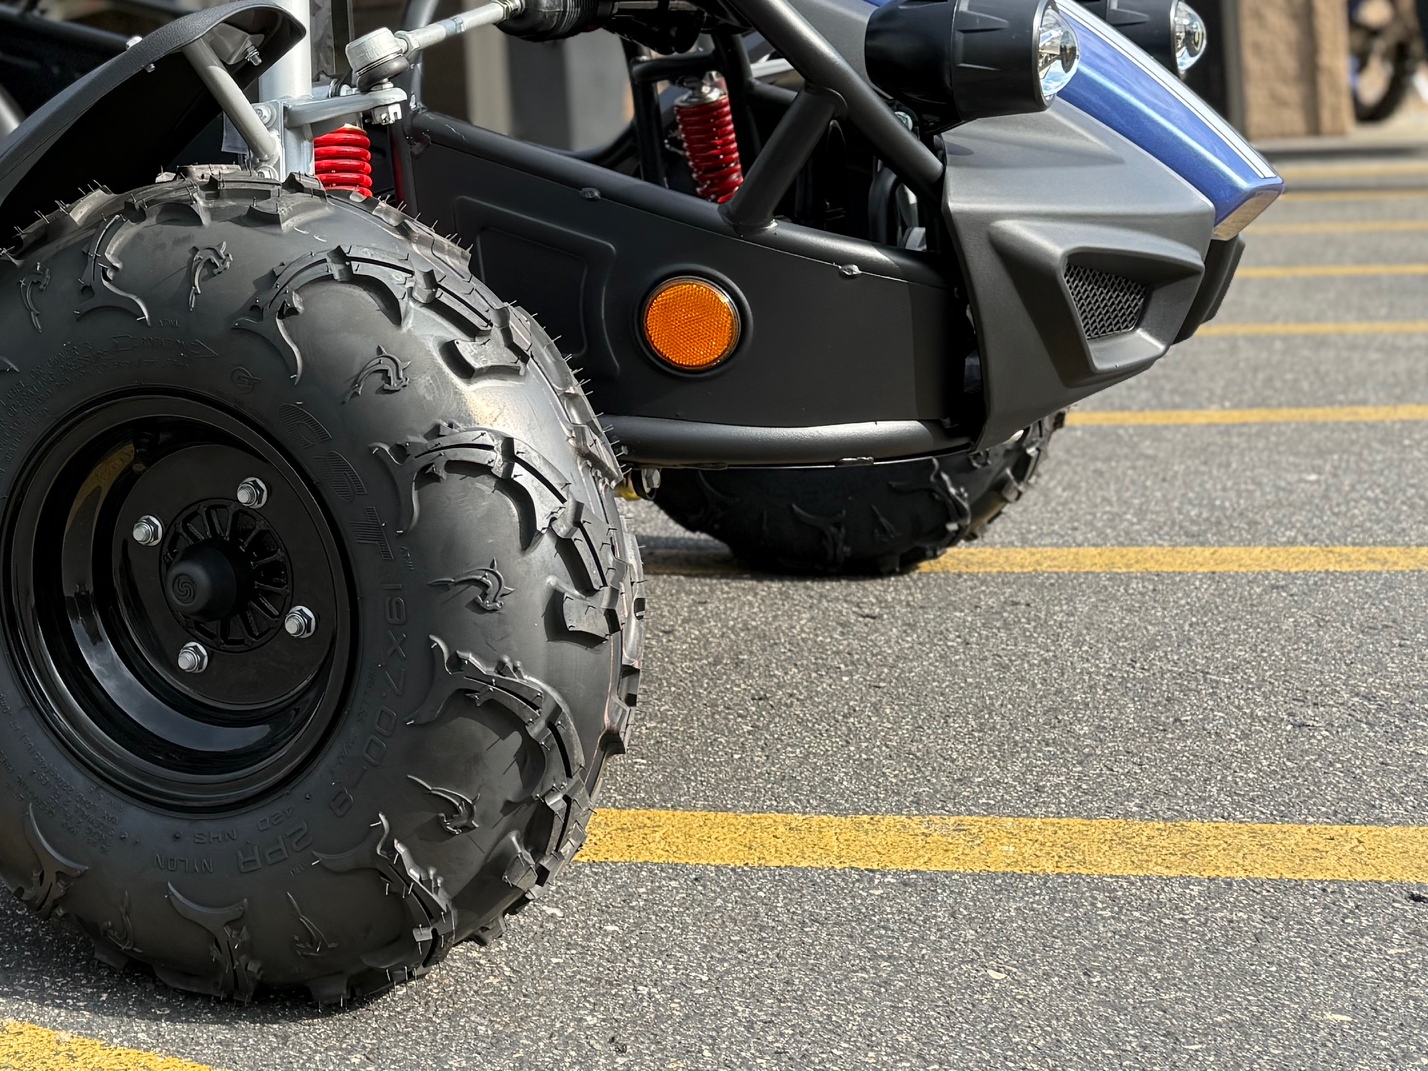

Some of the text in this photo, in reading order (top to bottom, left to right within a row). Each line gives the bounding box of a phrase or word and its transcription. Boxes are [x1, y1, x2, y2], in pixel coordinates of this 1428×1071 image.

[0, 377, 26, 408] LABEL
[5, 368, 56, 419] OPERATING
[58, 345, 110, 377] PRESSURE
[193, 828, 238, 845] NHS
[235, 820, 314, 874] 2PR
[153, 853, 214, 874] NYLON
